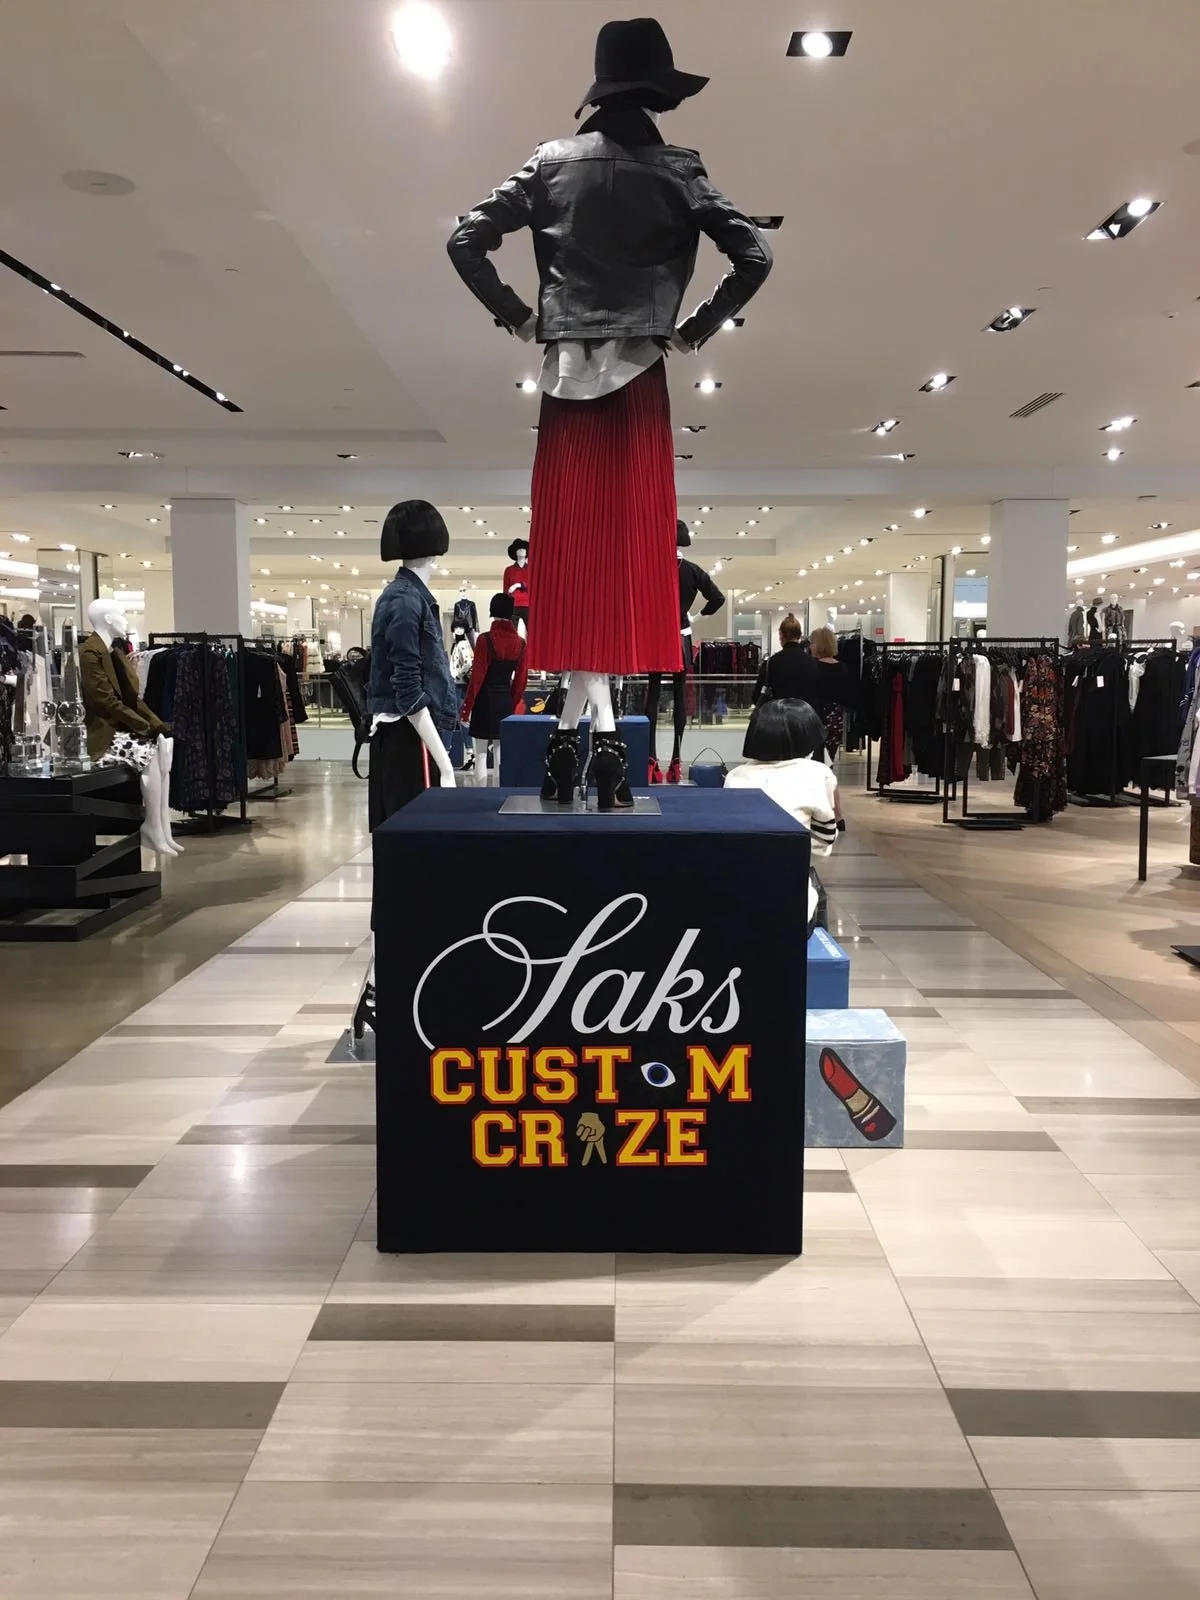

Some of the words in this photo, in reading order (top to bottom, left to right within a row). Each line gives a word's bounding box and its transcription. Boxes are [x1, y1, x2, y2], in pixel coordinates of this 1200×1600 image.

[413, 892, 742, 1051] Saks
[429, 1044, 753, 1105] CUSTM
[472, 1108, 708, 1168] CRZE
